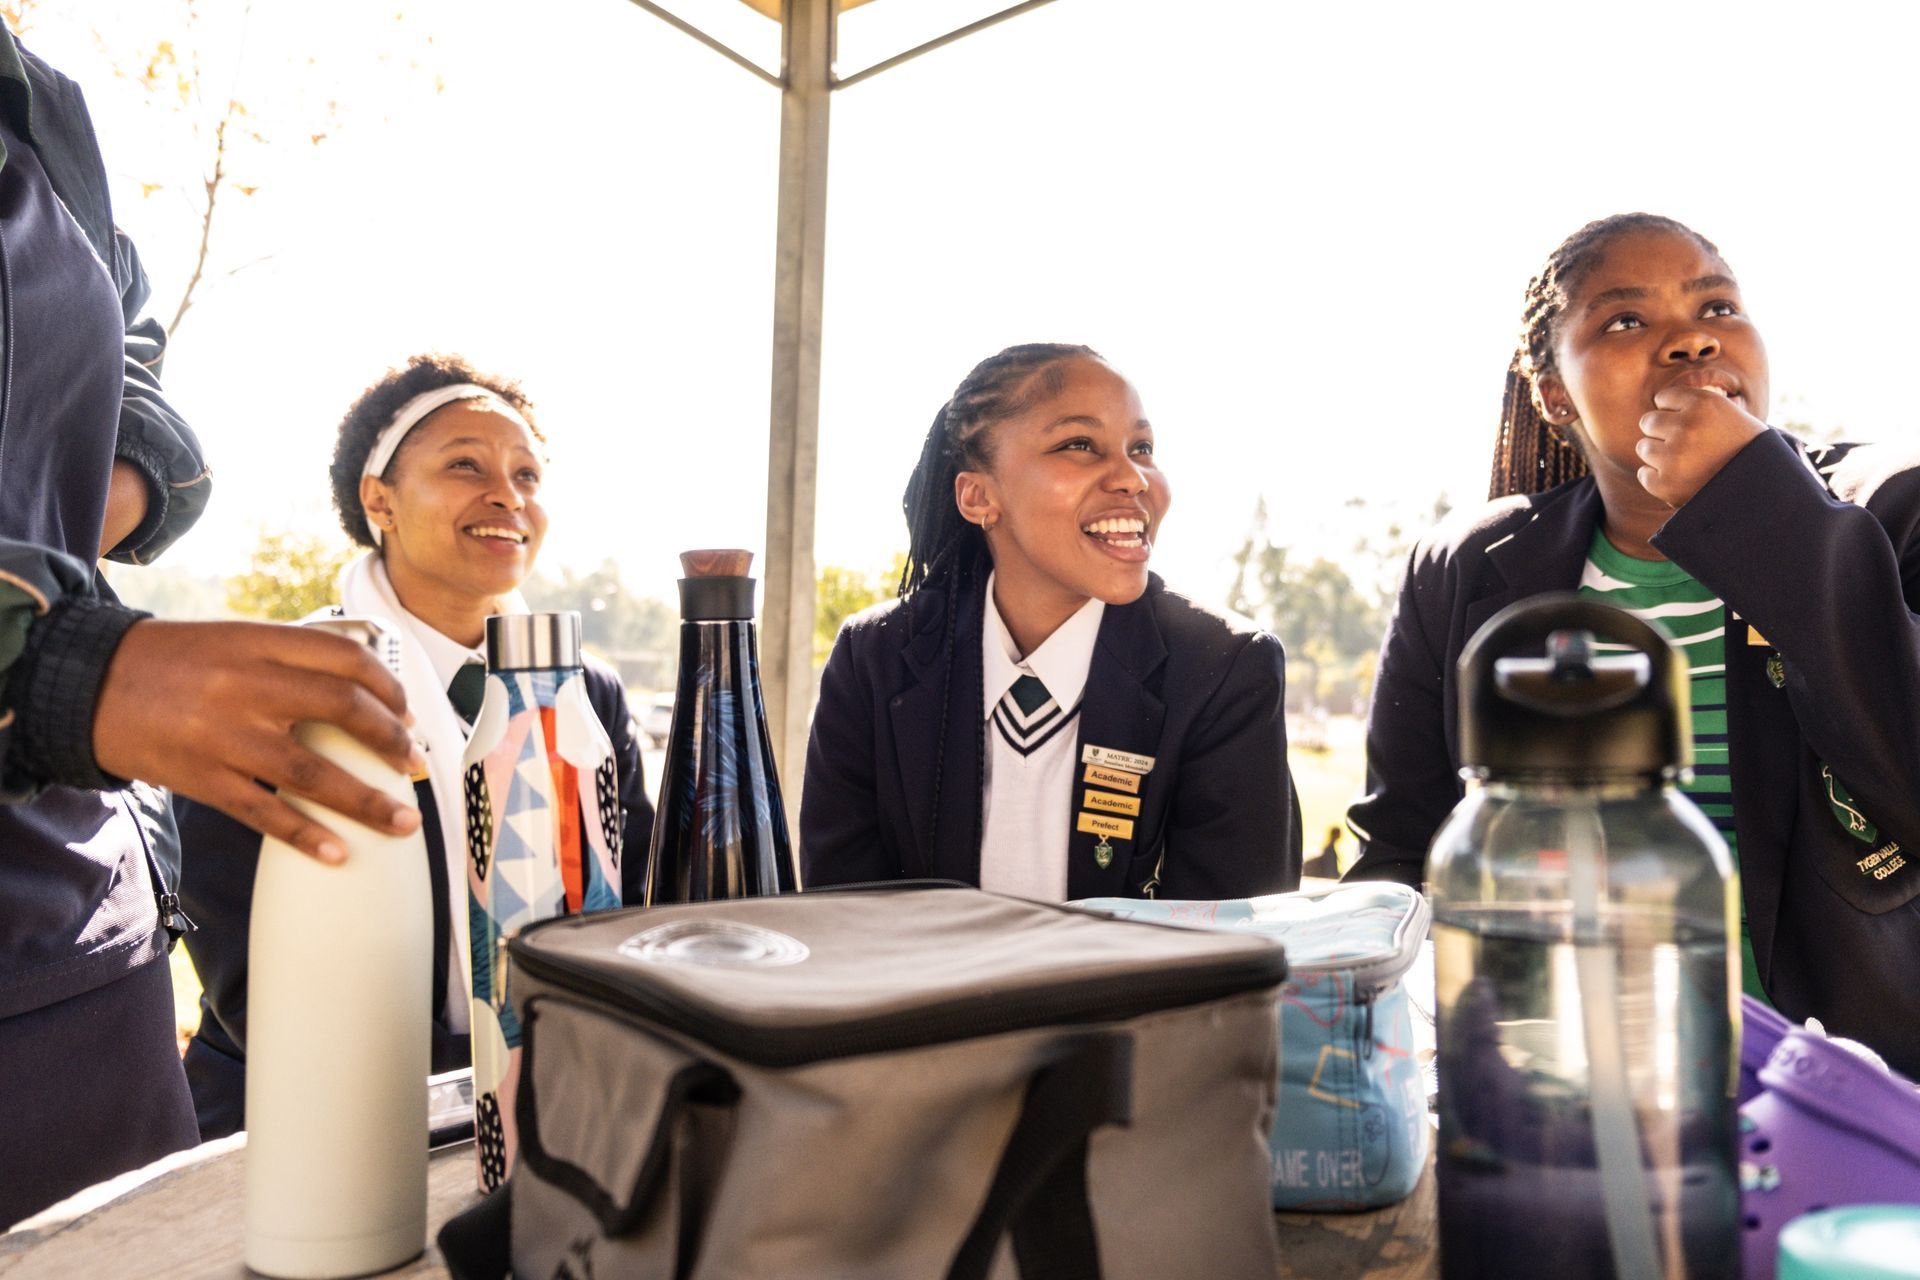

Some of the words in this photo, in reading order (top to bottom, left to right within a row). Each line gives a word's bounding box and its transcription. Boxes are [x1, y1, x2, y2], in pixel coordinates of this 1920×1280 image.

[1107, 753, 1133, 763] MATRIC
[1134, 758, 1148, 766] 2024
[1091, 770, 1133, 787] Academic
[1090, 796, 1133, 810] Academic
[1091, 819, 1120, 831] Prefect
[1873, 855, 1907, 880] COLLEGE
[1270, 1150, 1311, 1188] AME
[1316, 1149, 1367, 1188] OVER
